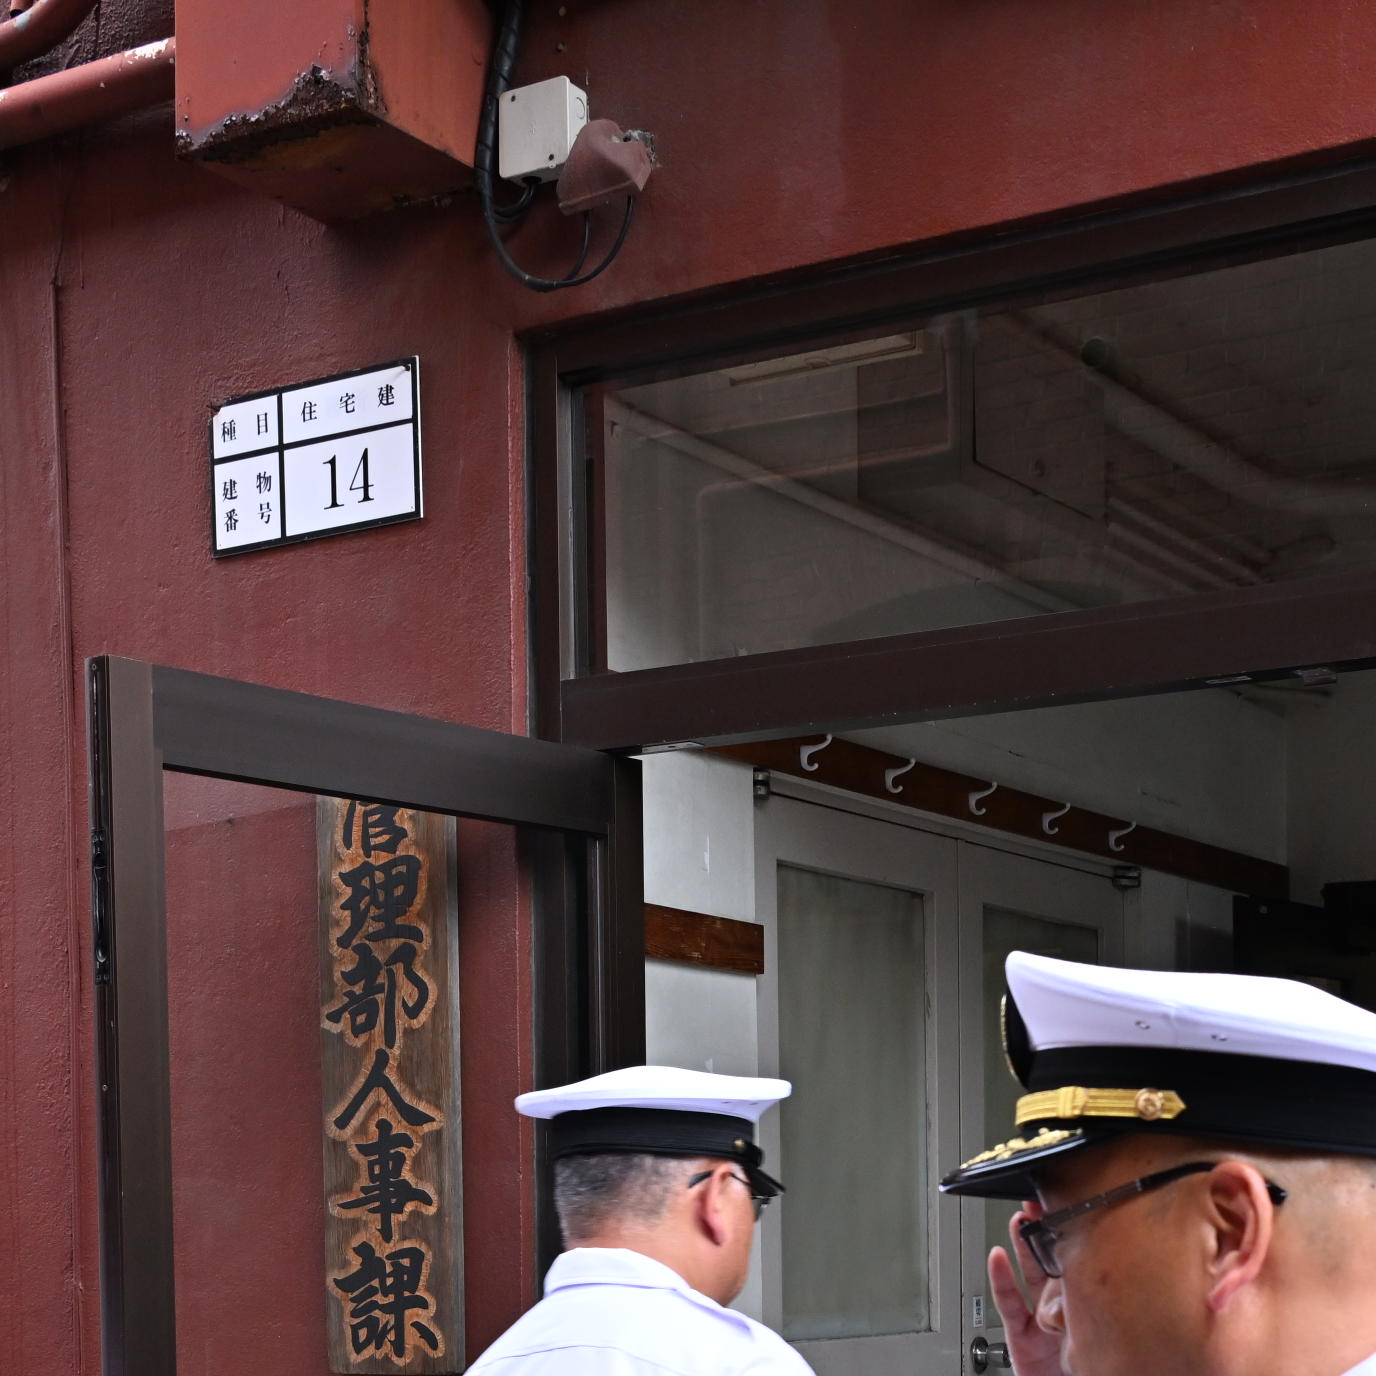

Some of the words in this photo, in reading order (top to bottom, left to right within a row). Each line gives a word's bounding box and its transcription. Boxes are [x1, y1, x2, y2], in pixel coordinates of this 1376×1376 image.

[301, 384, 395, 423] 住宅建
[221, 412, 269, 443] 種目
[222, 471, 272, 502] 建物
[322, 447, 375, 510] 14
[224, 502, 273, 533] 番号
